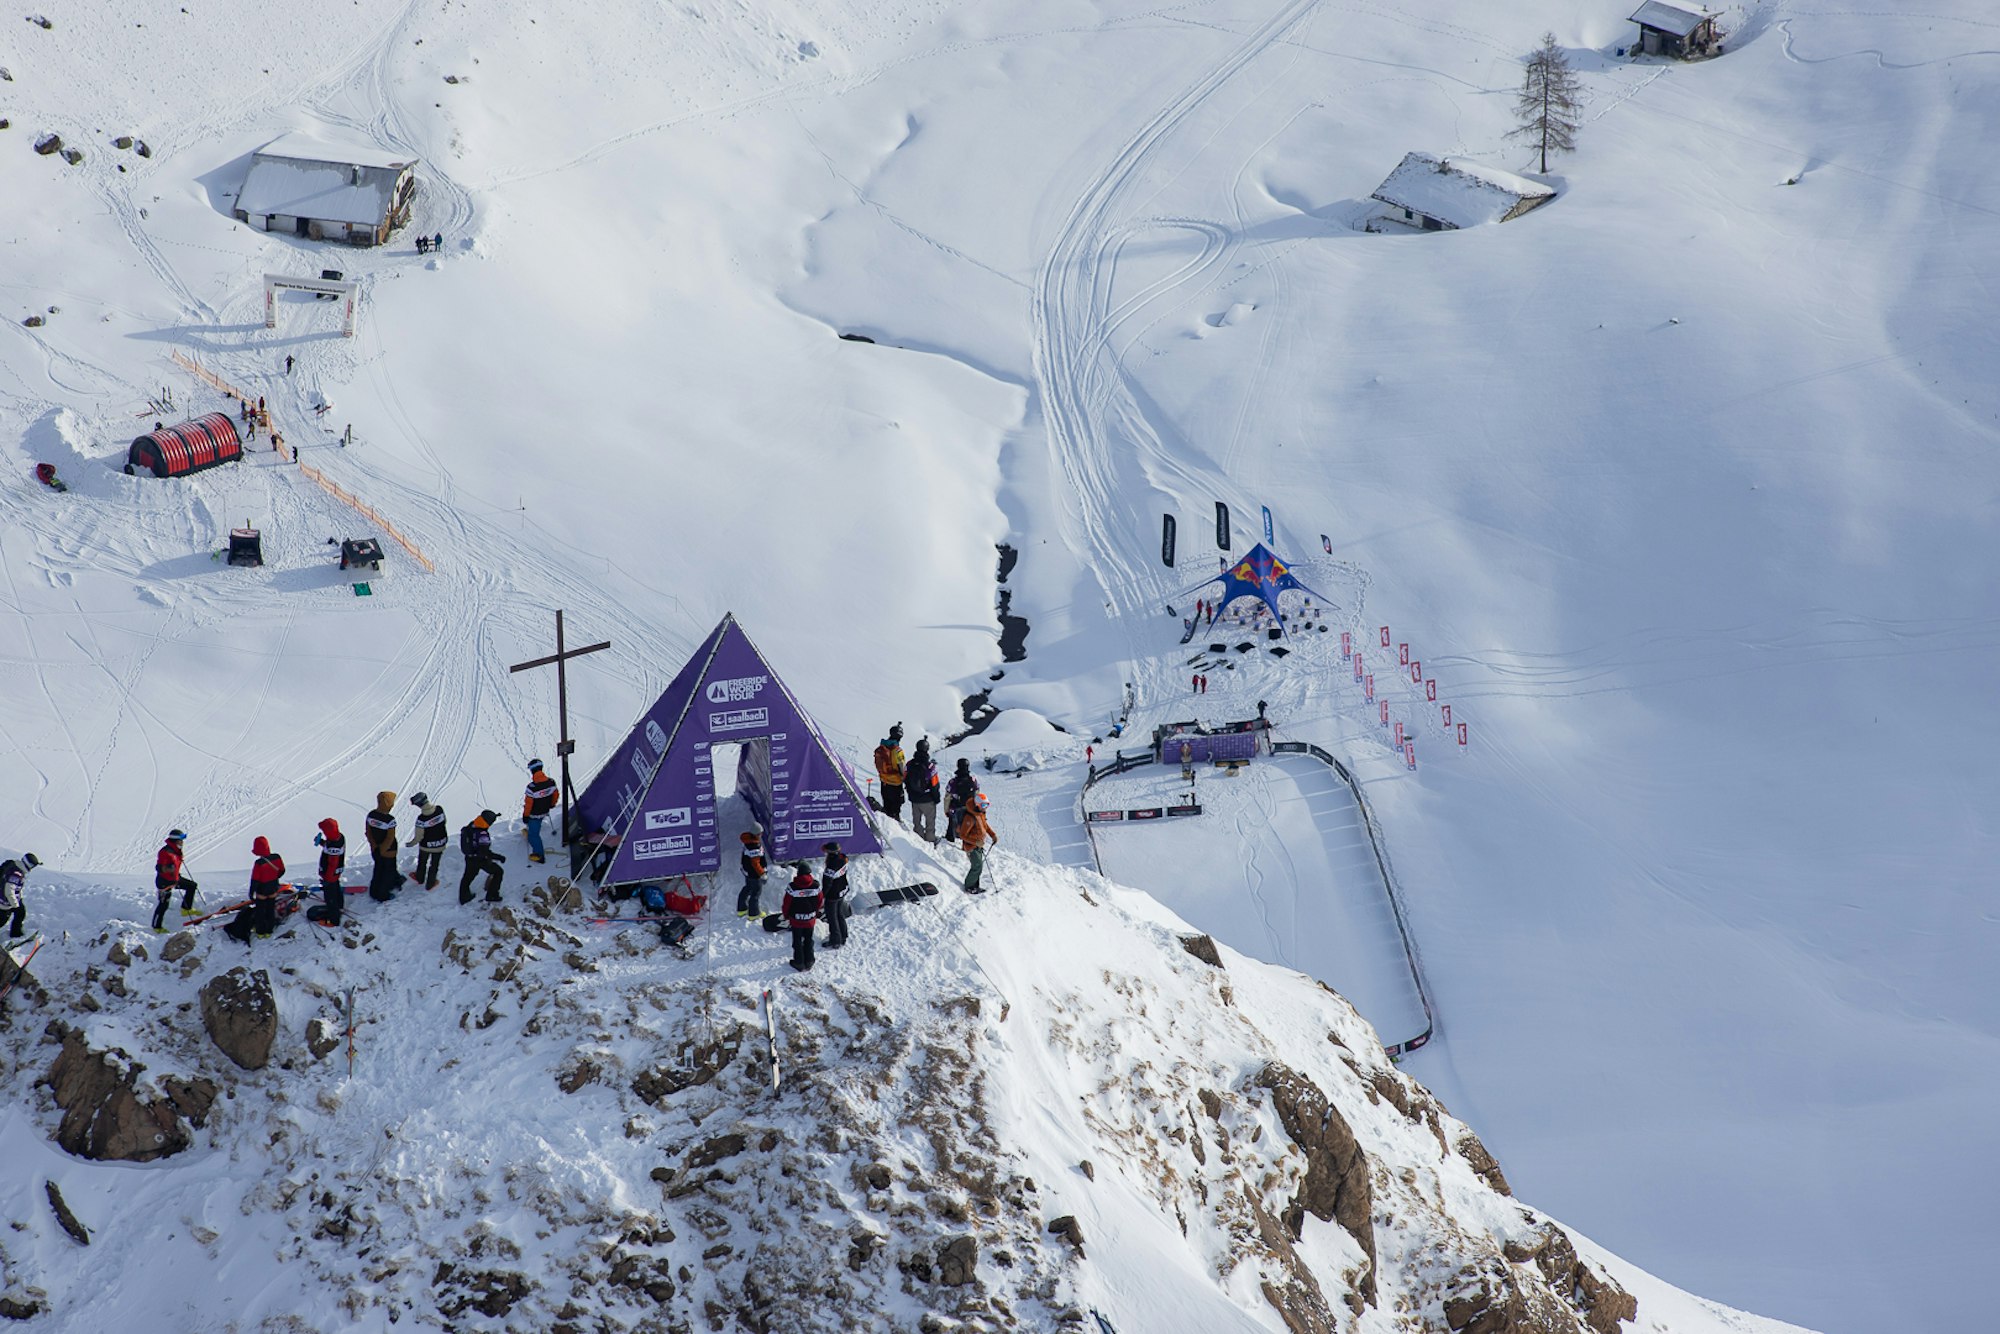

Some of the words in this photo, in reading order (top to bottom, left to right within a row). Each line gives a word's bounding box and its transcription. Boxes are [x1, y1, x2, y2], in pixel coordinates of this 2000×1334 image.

[728, 675, 768, 687] FREERIDE
[729, 683, 763, 694] WORLD
[729, 692, 755, 702] TOUR
[728, 711, 764, 723] saalbach
[651, 811, 685, 824] Tirol
[812, 818, 849, 831] saalbach
[651, 837, 689, 851] saalbach
